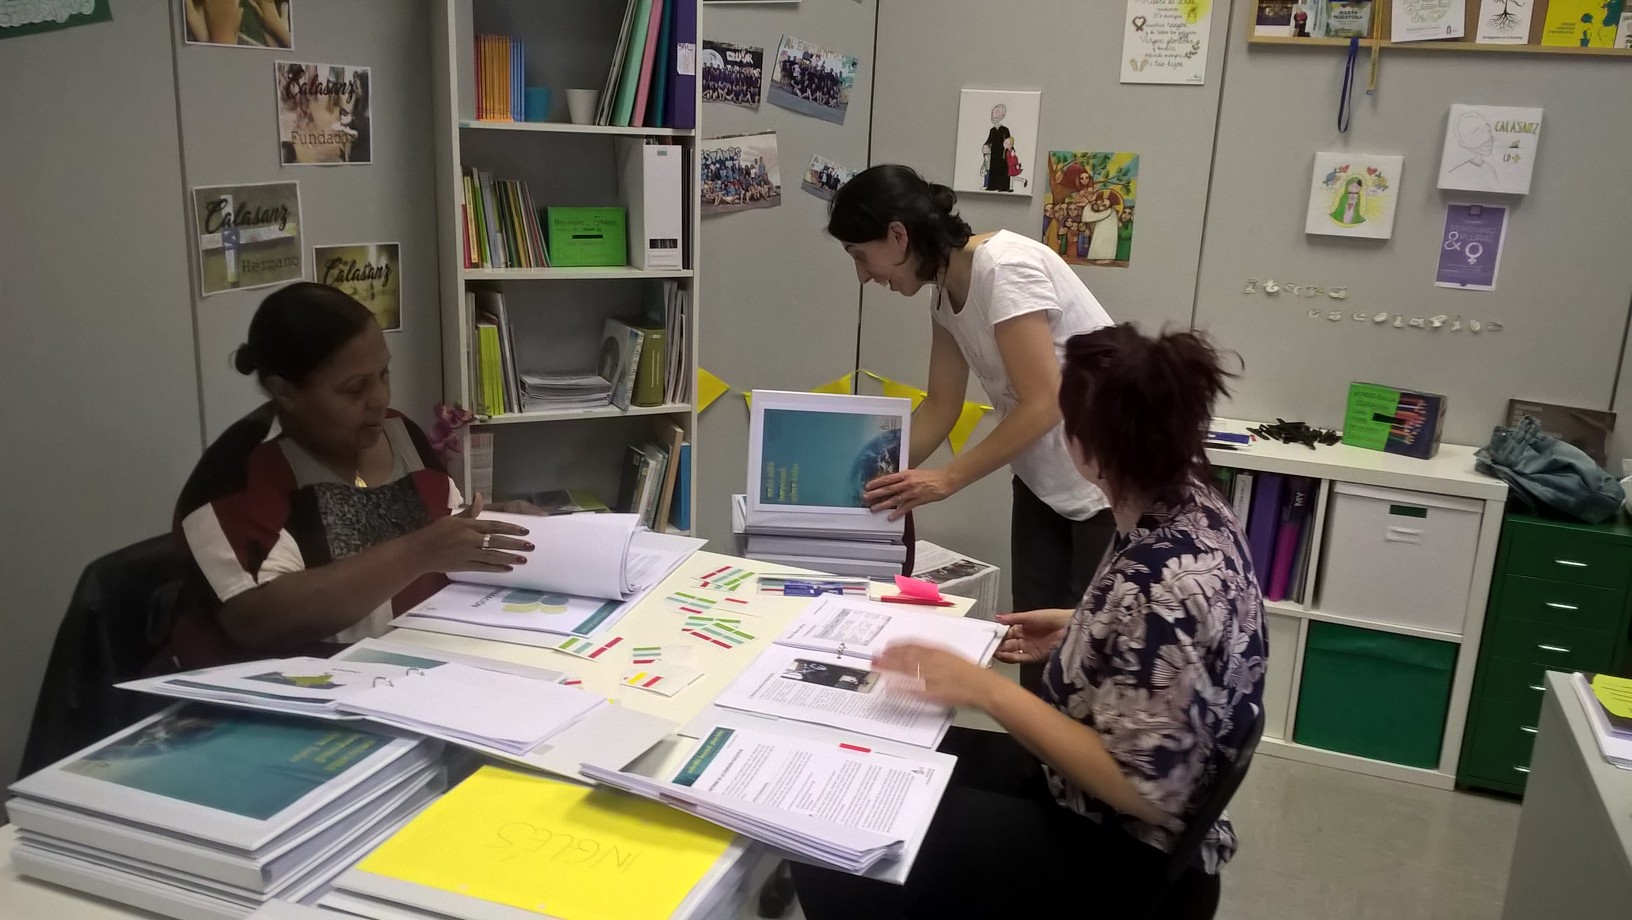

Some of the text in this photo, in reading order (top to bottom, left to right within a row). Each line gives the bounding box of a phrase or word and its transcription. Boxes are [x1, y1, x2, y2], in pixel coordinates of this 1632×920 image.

[285, 76, 355, 104] Calasanz
[205, 197, 290, 235] Calasanz
[1444, 231, 1461, 251] &
[242, 254, 299, 274] Hermano
[323, 256, 391, 288] Calasanz
